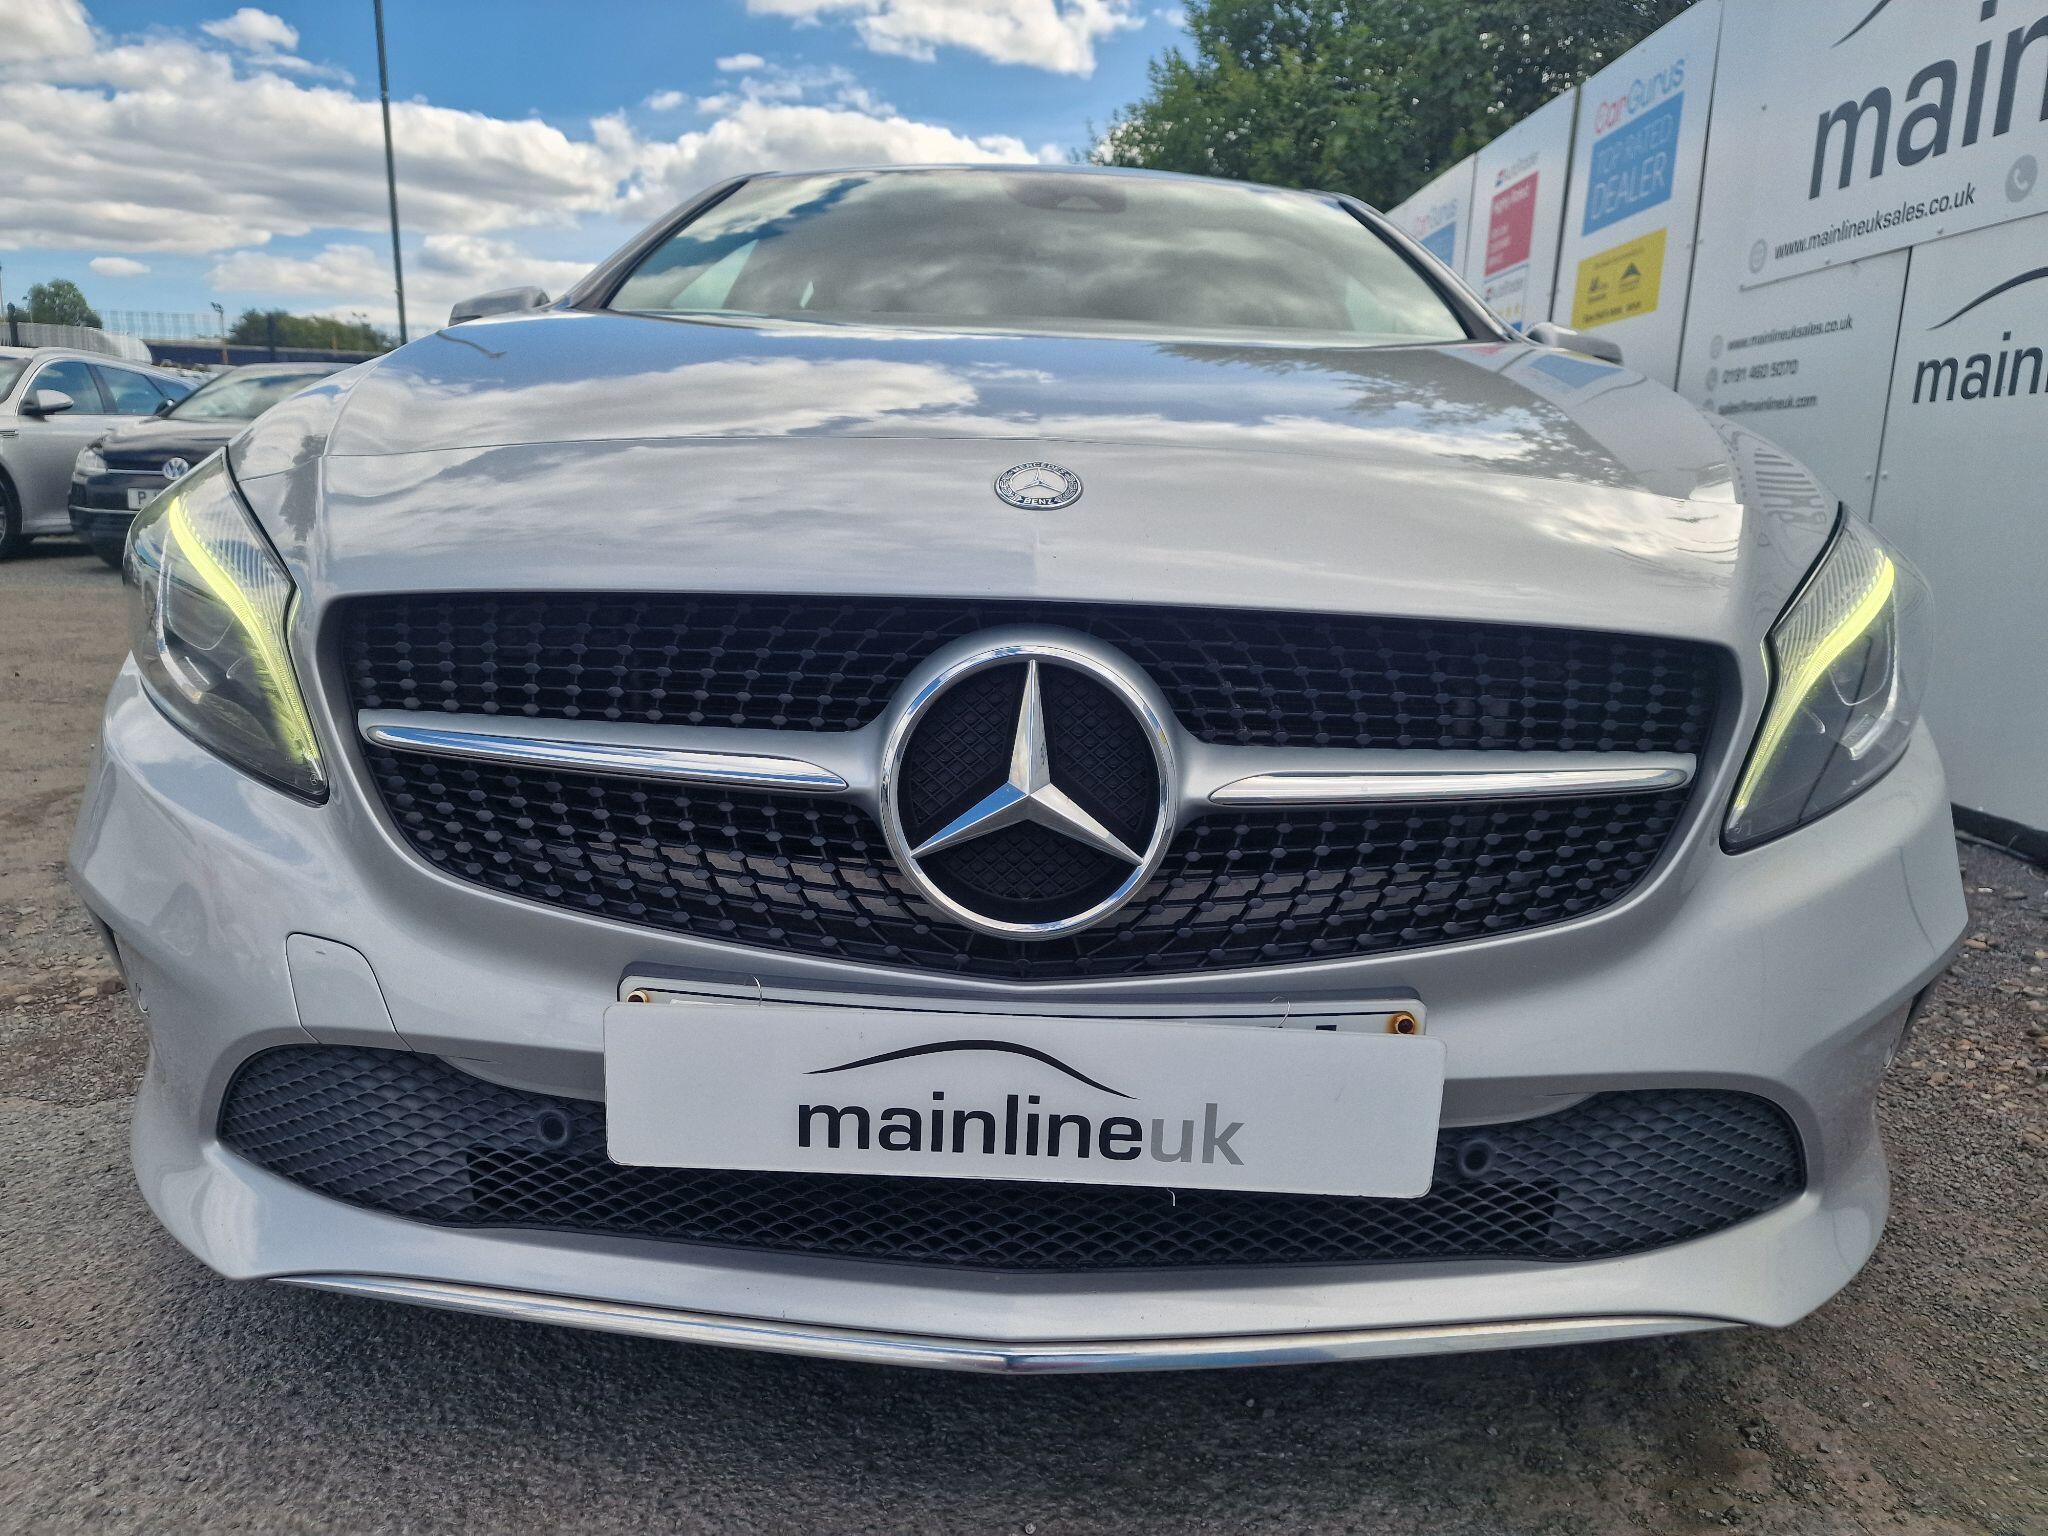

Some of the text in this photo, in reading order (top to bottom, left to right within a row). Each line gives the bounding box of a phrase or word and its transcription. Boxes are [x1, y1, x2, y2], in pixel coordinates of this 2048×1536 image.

[1592, 151, 1667, 220] DEALER
[1775, 182, 1976, 260] www.mainlineuksales.co.uk
[1911, 330, 2048, 404] main
[1023, 497, 1054, 505] BENZ
[798, 1091, 1246, 1166] mainlineuk
